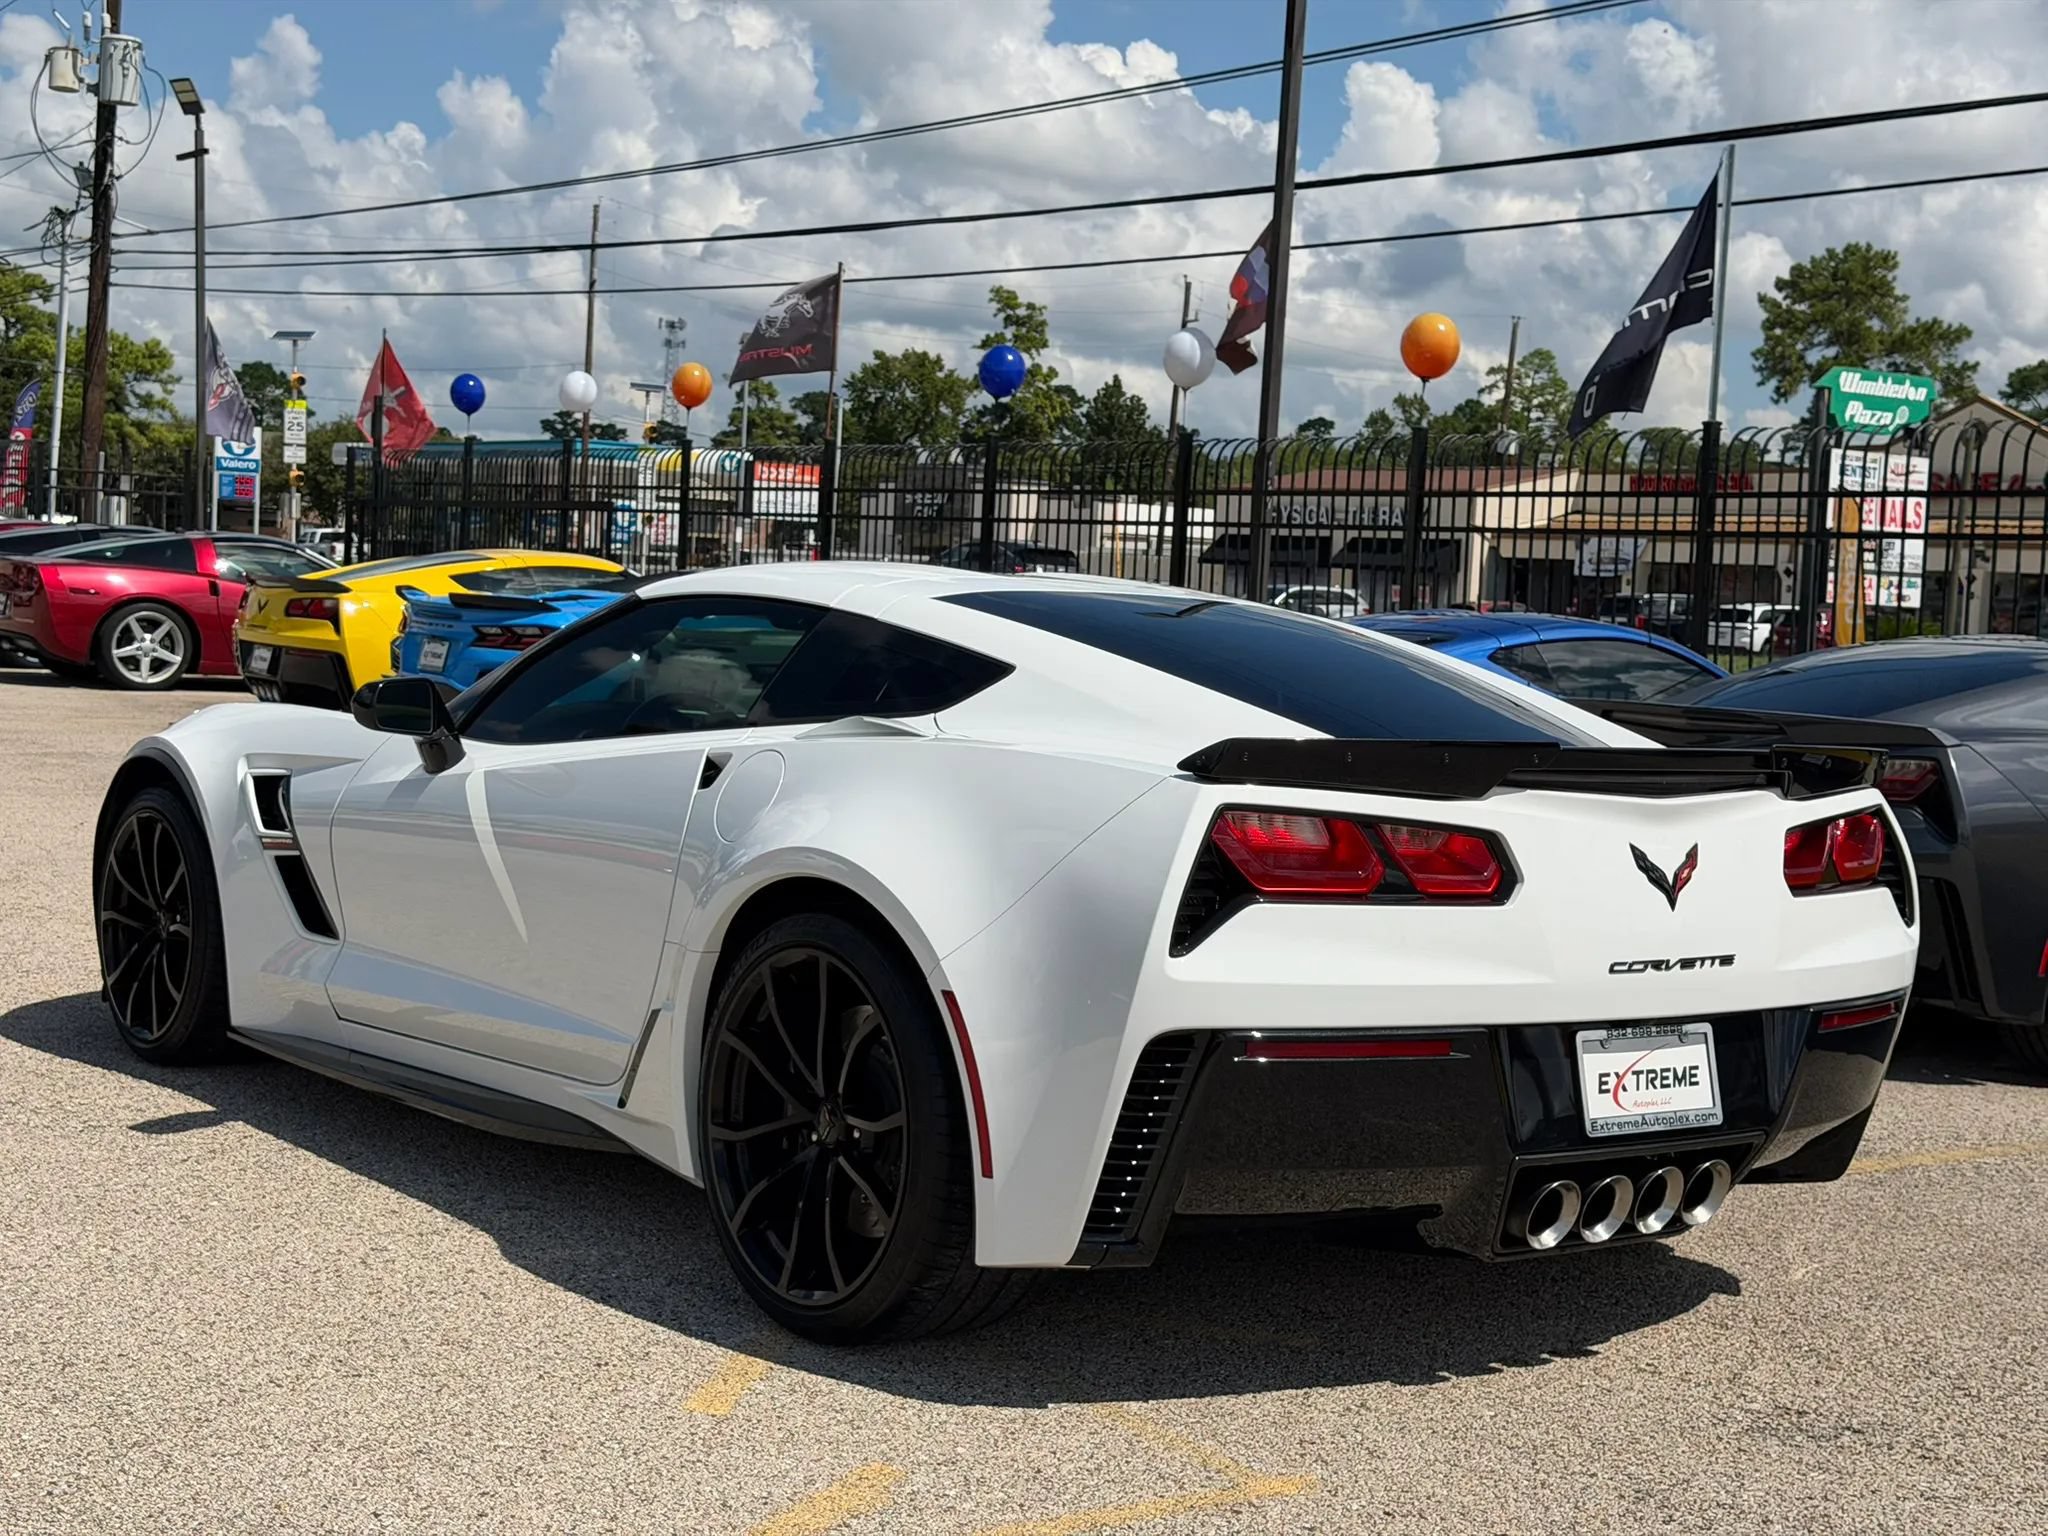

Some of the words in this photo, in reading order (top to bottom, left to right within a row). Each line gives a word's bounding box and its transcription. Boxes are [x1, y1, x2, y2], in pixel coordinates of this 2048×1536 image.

[1839, 371, 1928, 402] Wimbledon
[1845, 400, 1895, 427] Plaza
[287, 420, 305, 432] 25
[220, 458, 257, 470] Valero
[1608, 954, 1736, 974] CORVETTE
[1598, 1065, 1700, 1095] EXTREME
[1591, 1111, 1719, 1132] ExtremeAutoplex.com
